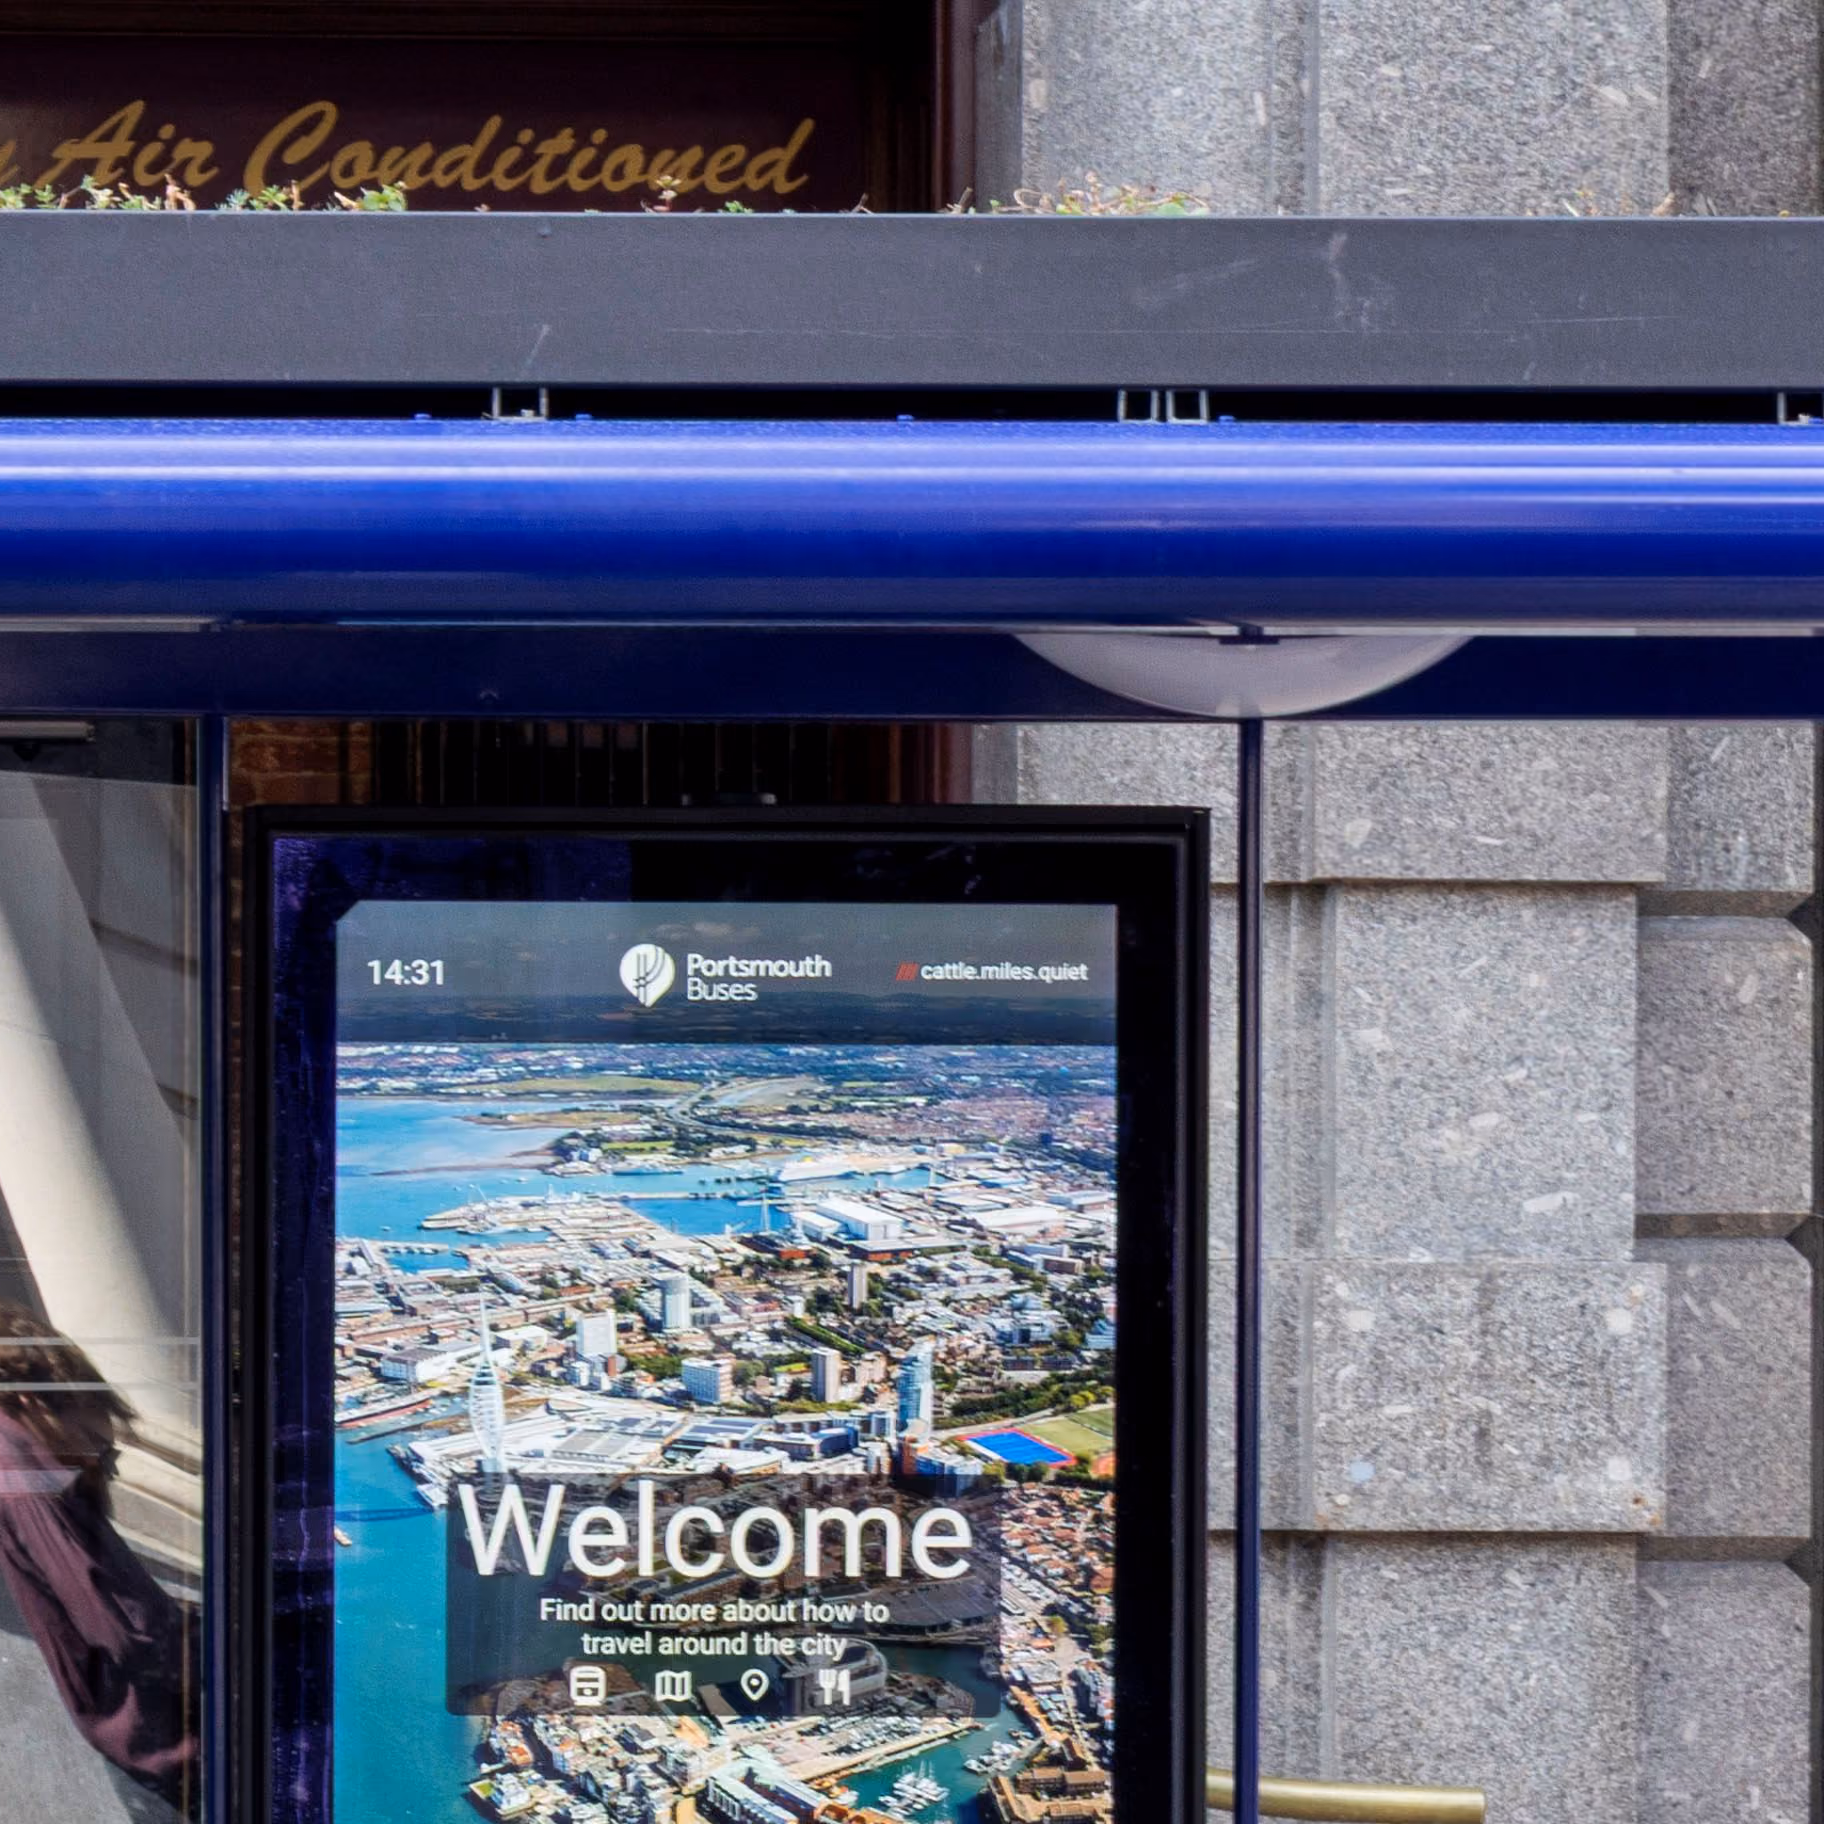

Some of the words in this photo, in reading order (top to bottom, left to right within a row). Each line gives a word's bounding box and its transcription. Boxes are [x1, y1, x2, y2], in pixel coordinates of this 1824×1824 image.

[48, 99, 216, 188] Air
[243, 99, 814, 197] Conditioned
[368, 960, 445, 985] 14:31
[687, 953, 832, 978] Portsmouth
[921, 962, 1088, 984] cattle.miles.quiet
[687, 979, 757, 1001] Buses
[458, 1481, 973, 1578] Welcome
[541, 1599, 595, 1622] Find
[601, 1600, 642, 1622] out
[650, 1603, 715, 1622] more
[723, 1599, 796, 1622] about
[803, 1599, 856, 1622] how
[863, 1600, 888, 1622] to
[582, 1632, 651, 1655] travel
[658, 1632, 747, 1655] around
[754, 1632, 794, 1655] the
[801, 1632, 846, 1661] city
